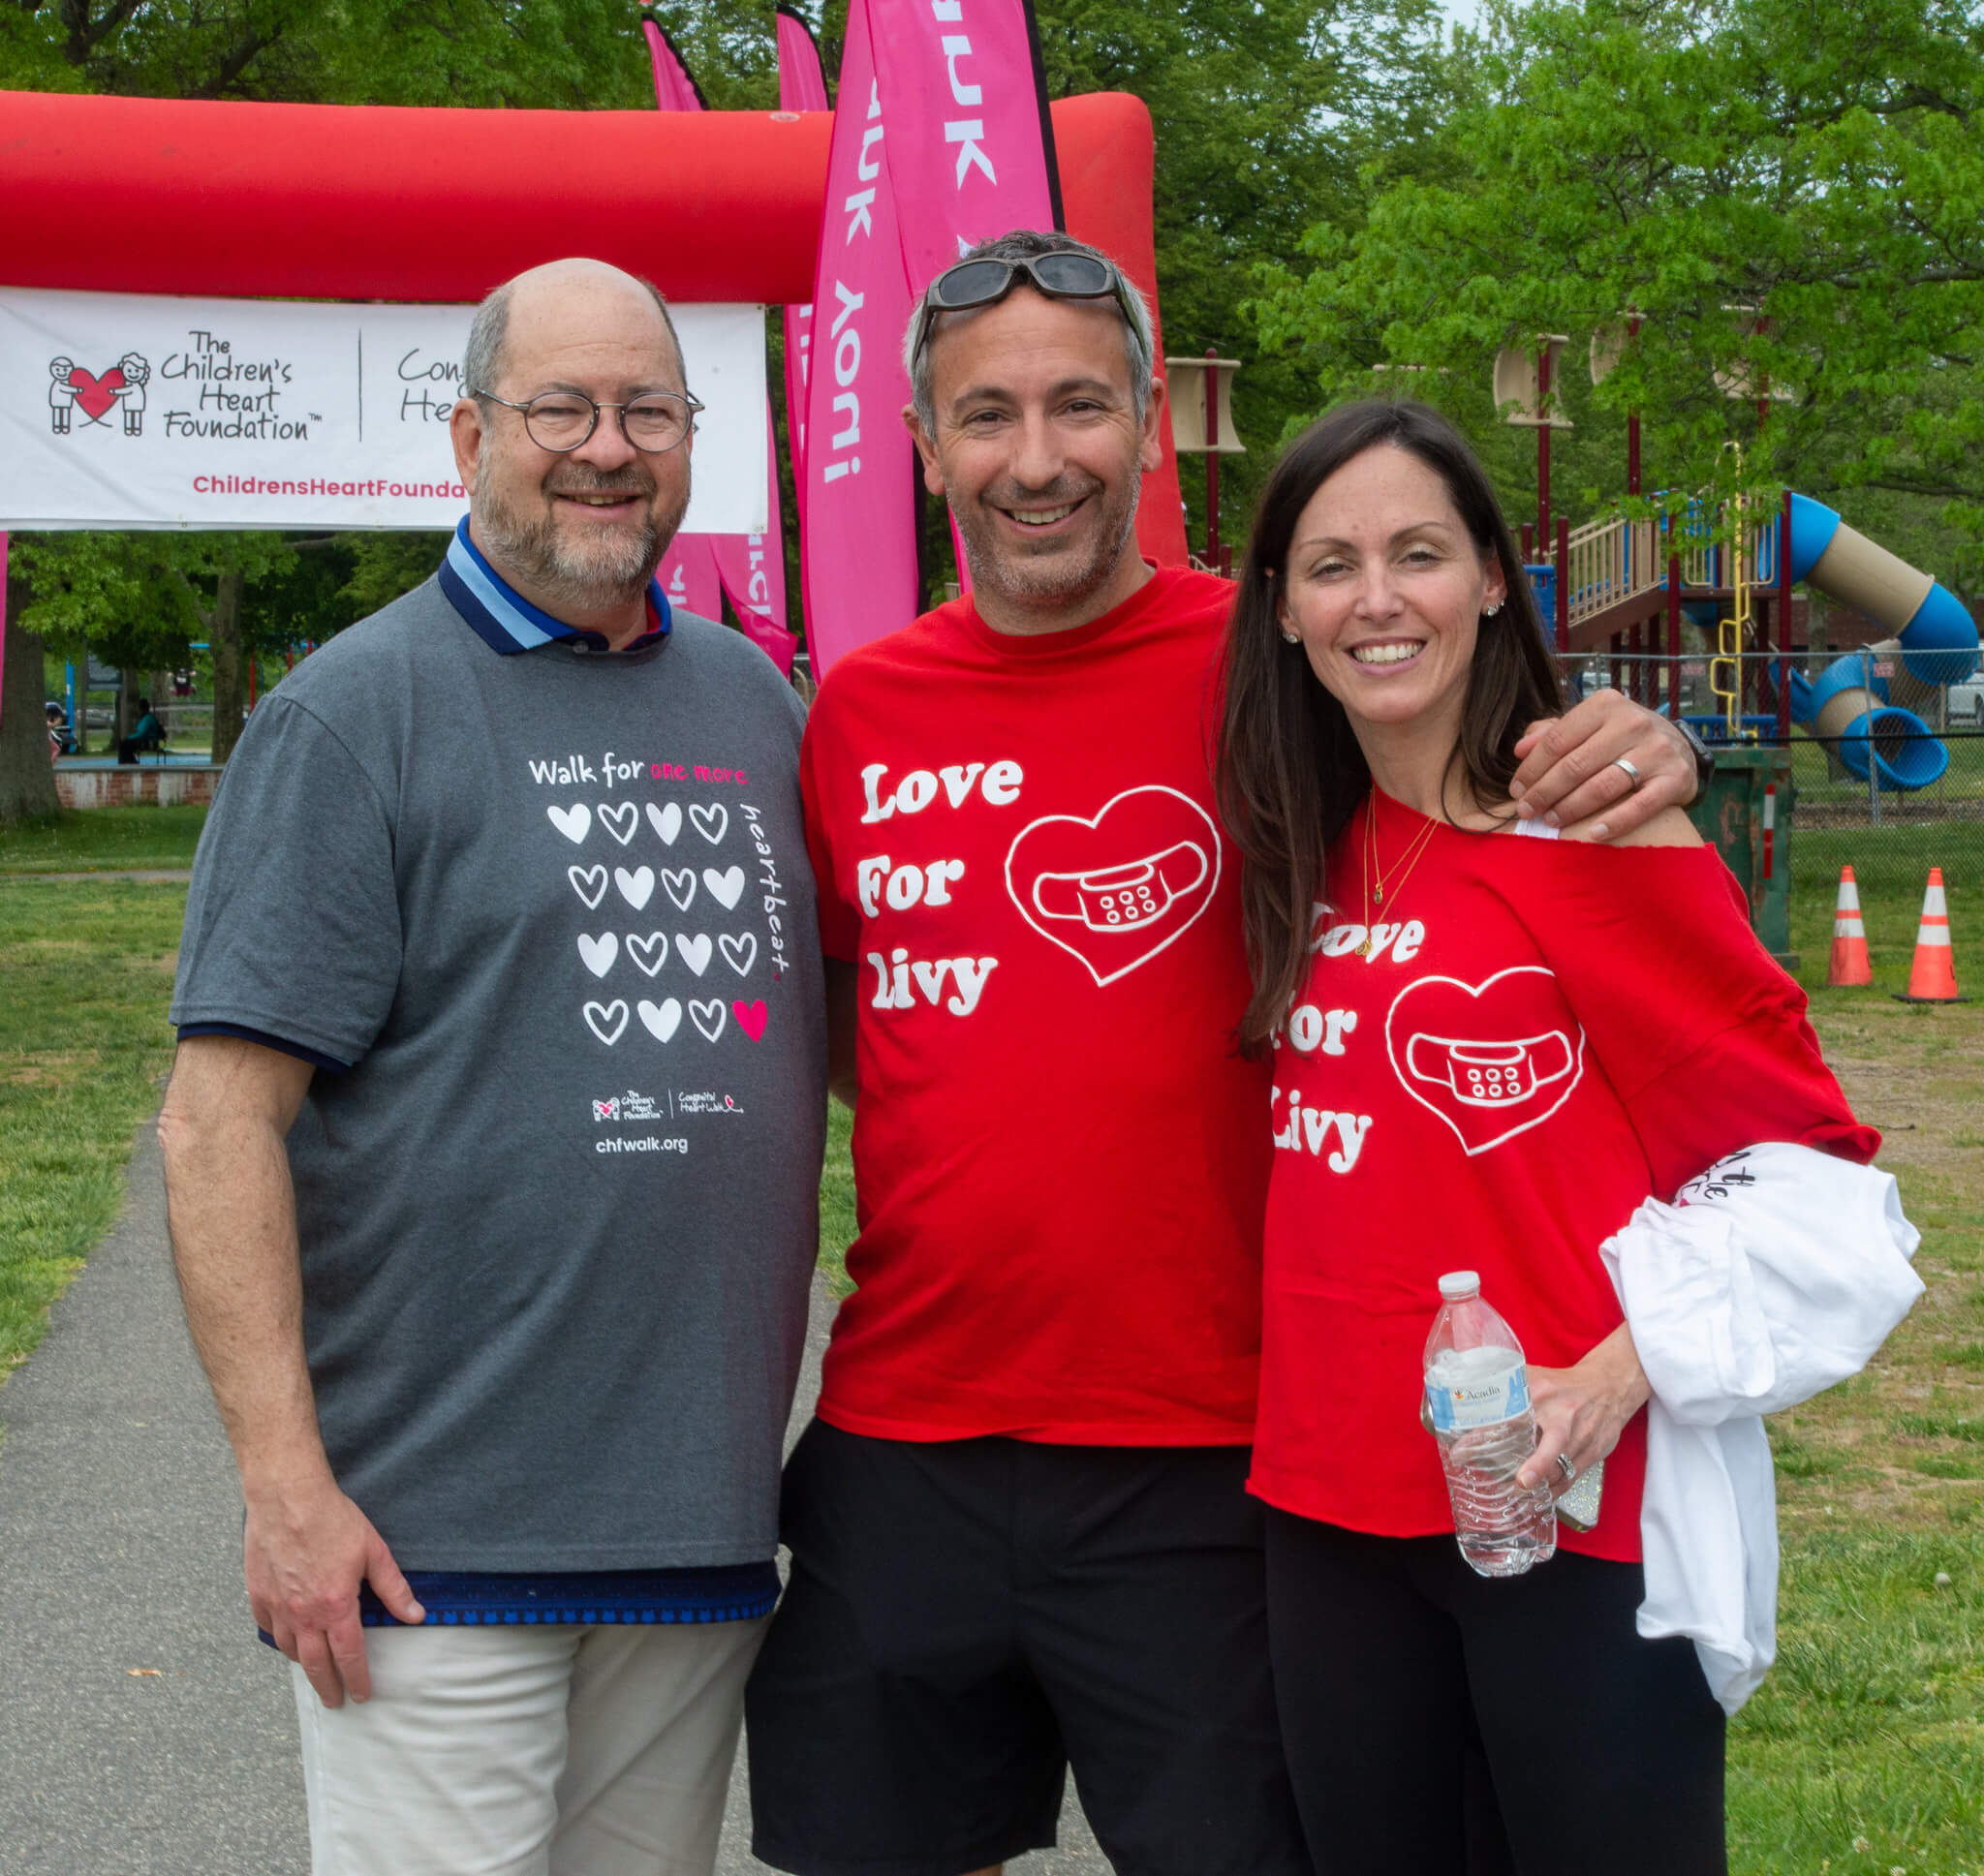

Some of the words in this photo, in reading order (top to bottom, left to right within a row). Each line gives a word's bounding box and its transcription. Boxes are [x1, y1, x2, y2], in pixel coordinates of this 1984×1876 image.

[189, 330, 231, 354] The
[161, 353, 293, 384] Children's
[397, 348, 468, 399] Con
[200, 383, 281, 413] Heart
[400, 388, 452, 422] He
[193, 475, 465, 498] ChildrensHeartFounda
[528, 754, 597, 785] Walk
[601, 752, 644, 788] for
[651, 762, 689, 782] one
[694, 764, 749, 785] more
[860, 760, 1024, 824] Love
[858, 855, 965, 918] For
[867, 947, 999, 1017] Livy
[1270, 990, 1357, 1057] or
[596, 1136, 689, 1154] chfwalk.org
